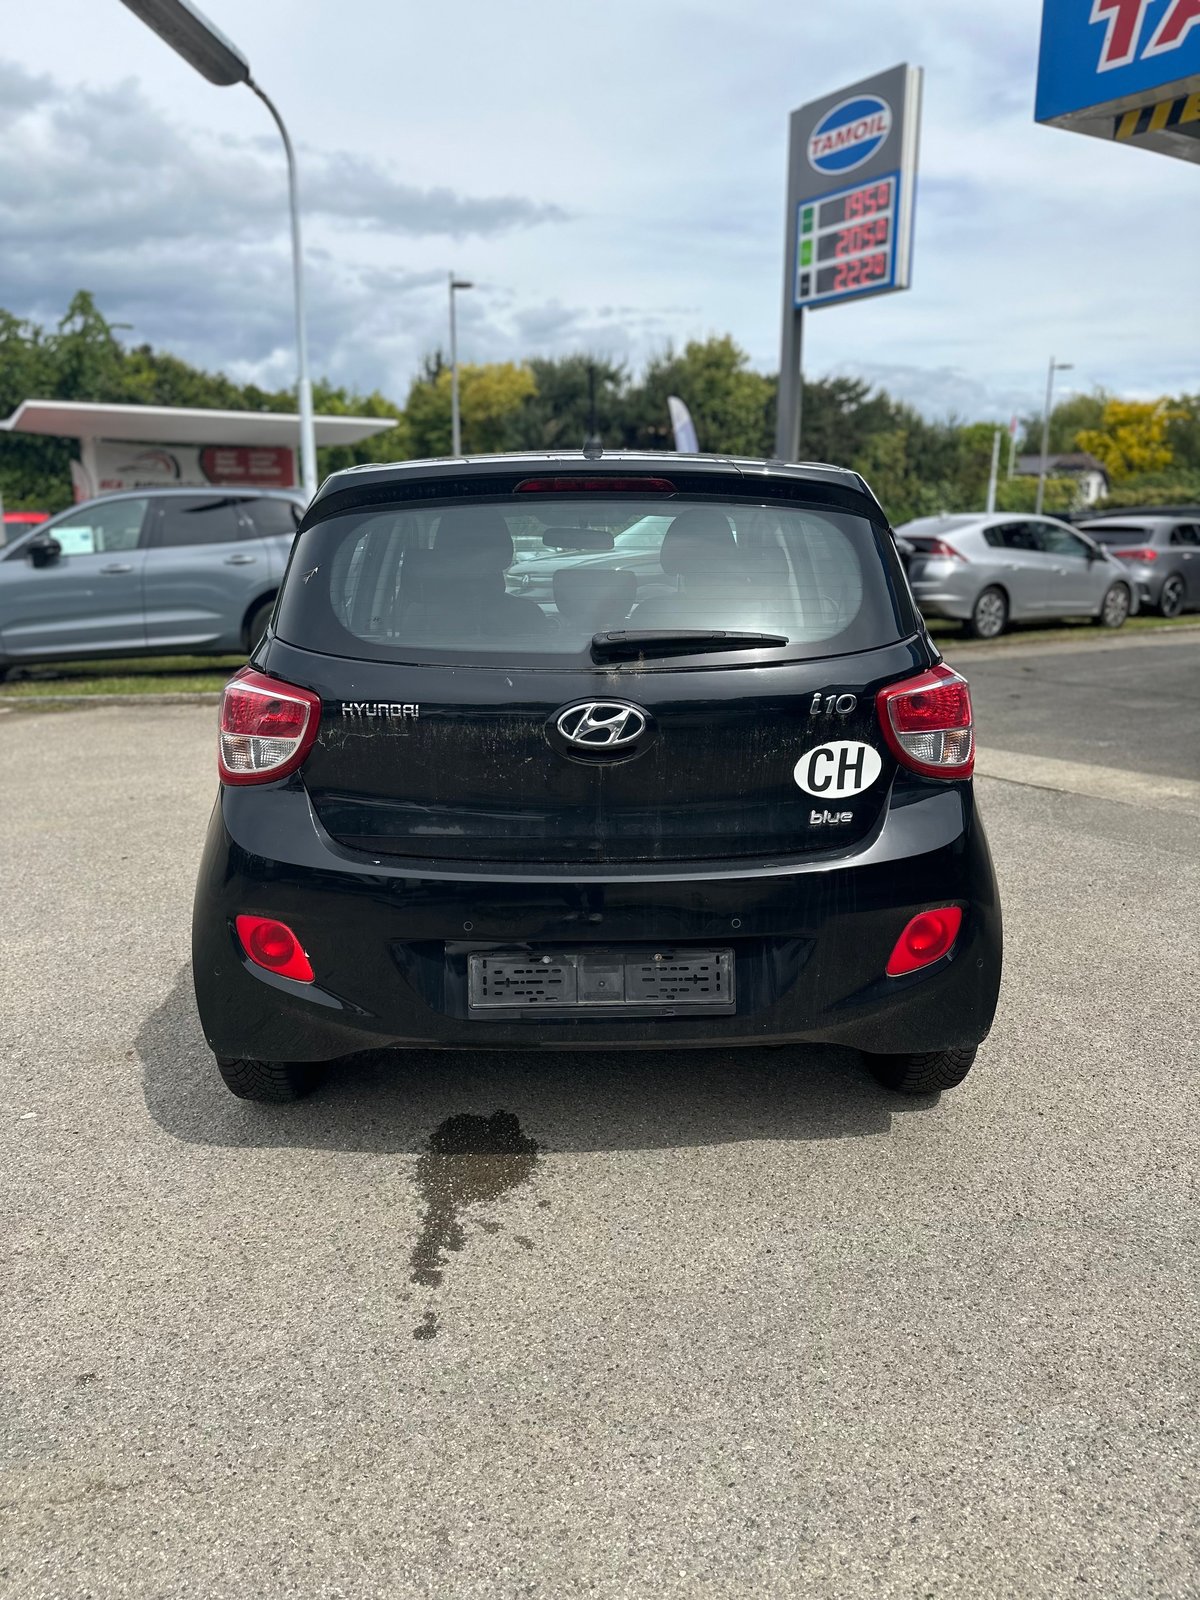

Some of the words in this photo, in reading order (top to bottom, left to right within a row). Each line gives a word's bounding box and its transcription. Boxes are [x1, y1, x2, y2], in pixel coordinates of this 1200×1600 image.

[811, 115, 887, 156] TAMOIL
[342, 702, 419, 717] HYUNDAI
[810, 692, 857, 715] i10
[807, 746, 866, 793] CH
[809, 809, 853, 825] blue
